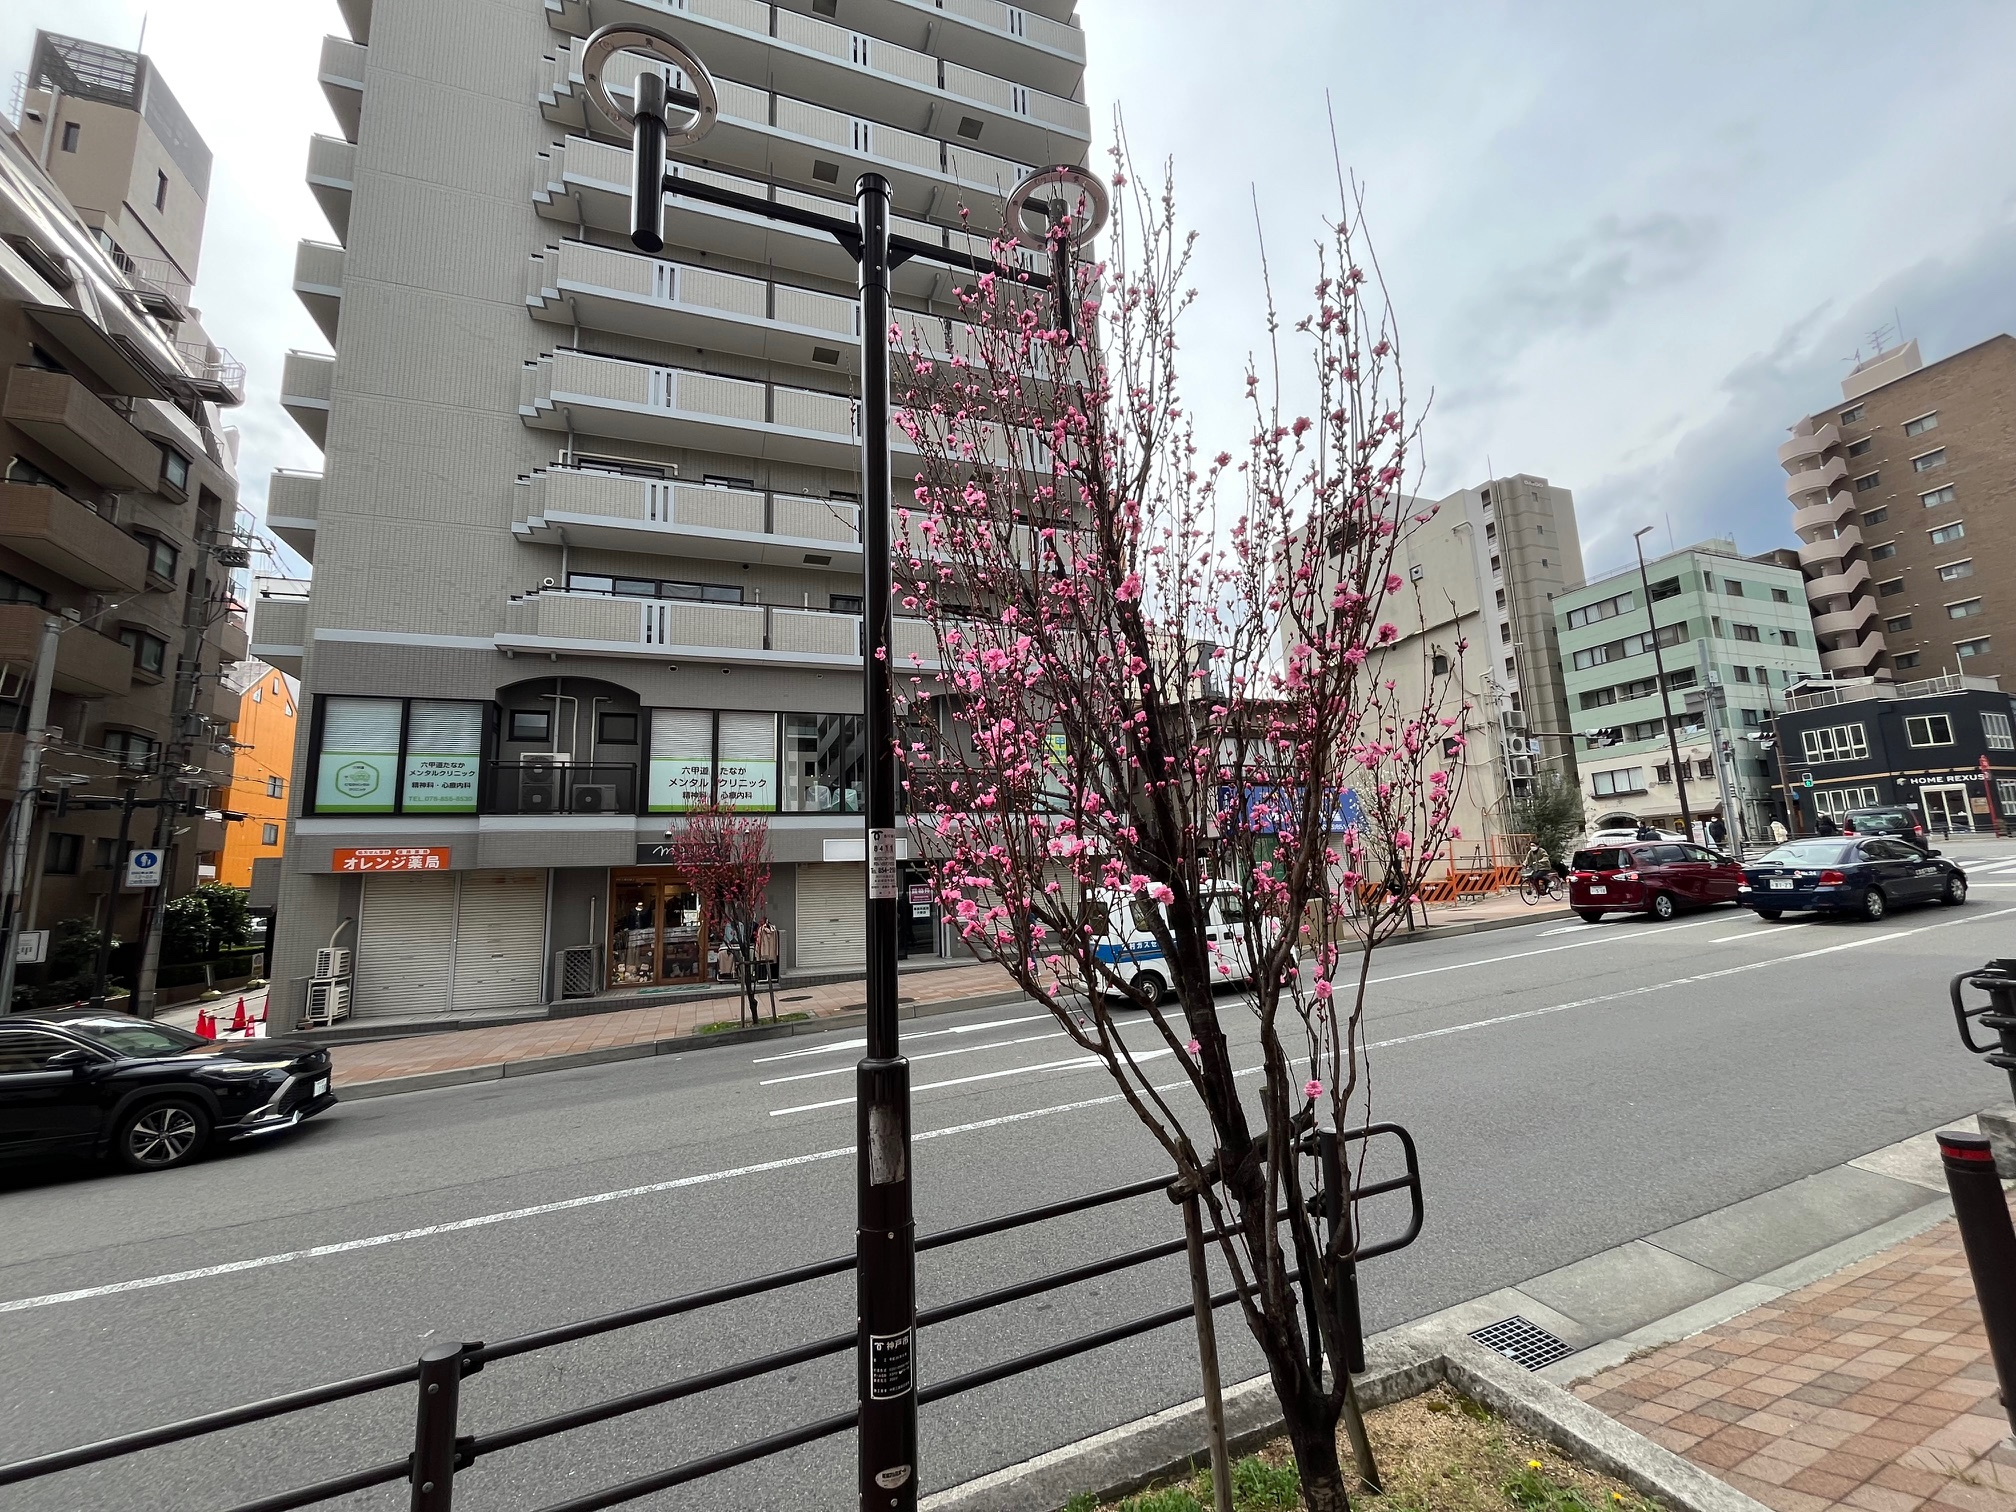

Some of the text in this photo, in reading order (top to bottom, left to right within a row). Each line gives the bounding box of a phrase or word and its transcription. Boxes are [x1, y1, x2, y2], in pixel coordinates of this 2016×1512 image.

[1910, 776, 1943, 785] HOME
[343, 855, 440, 870] オレンジ薬局
